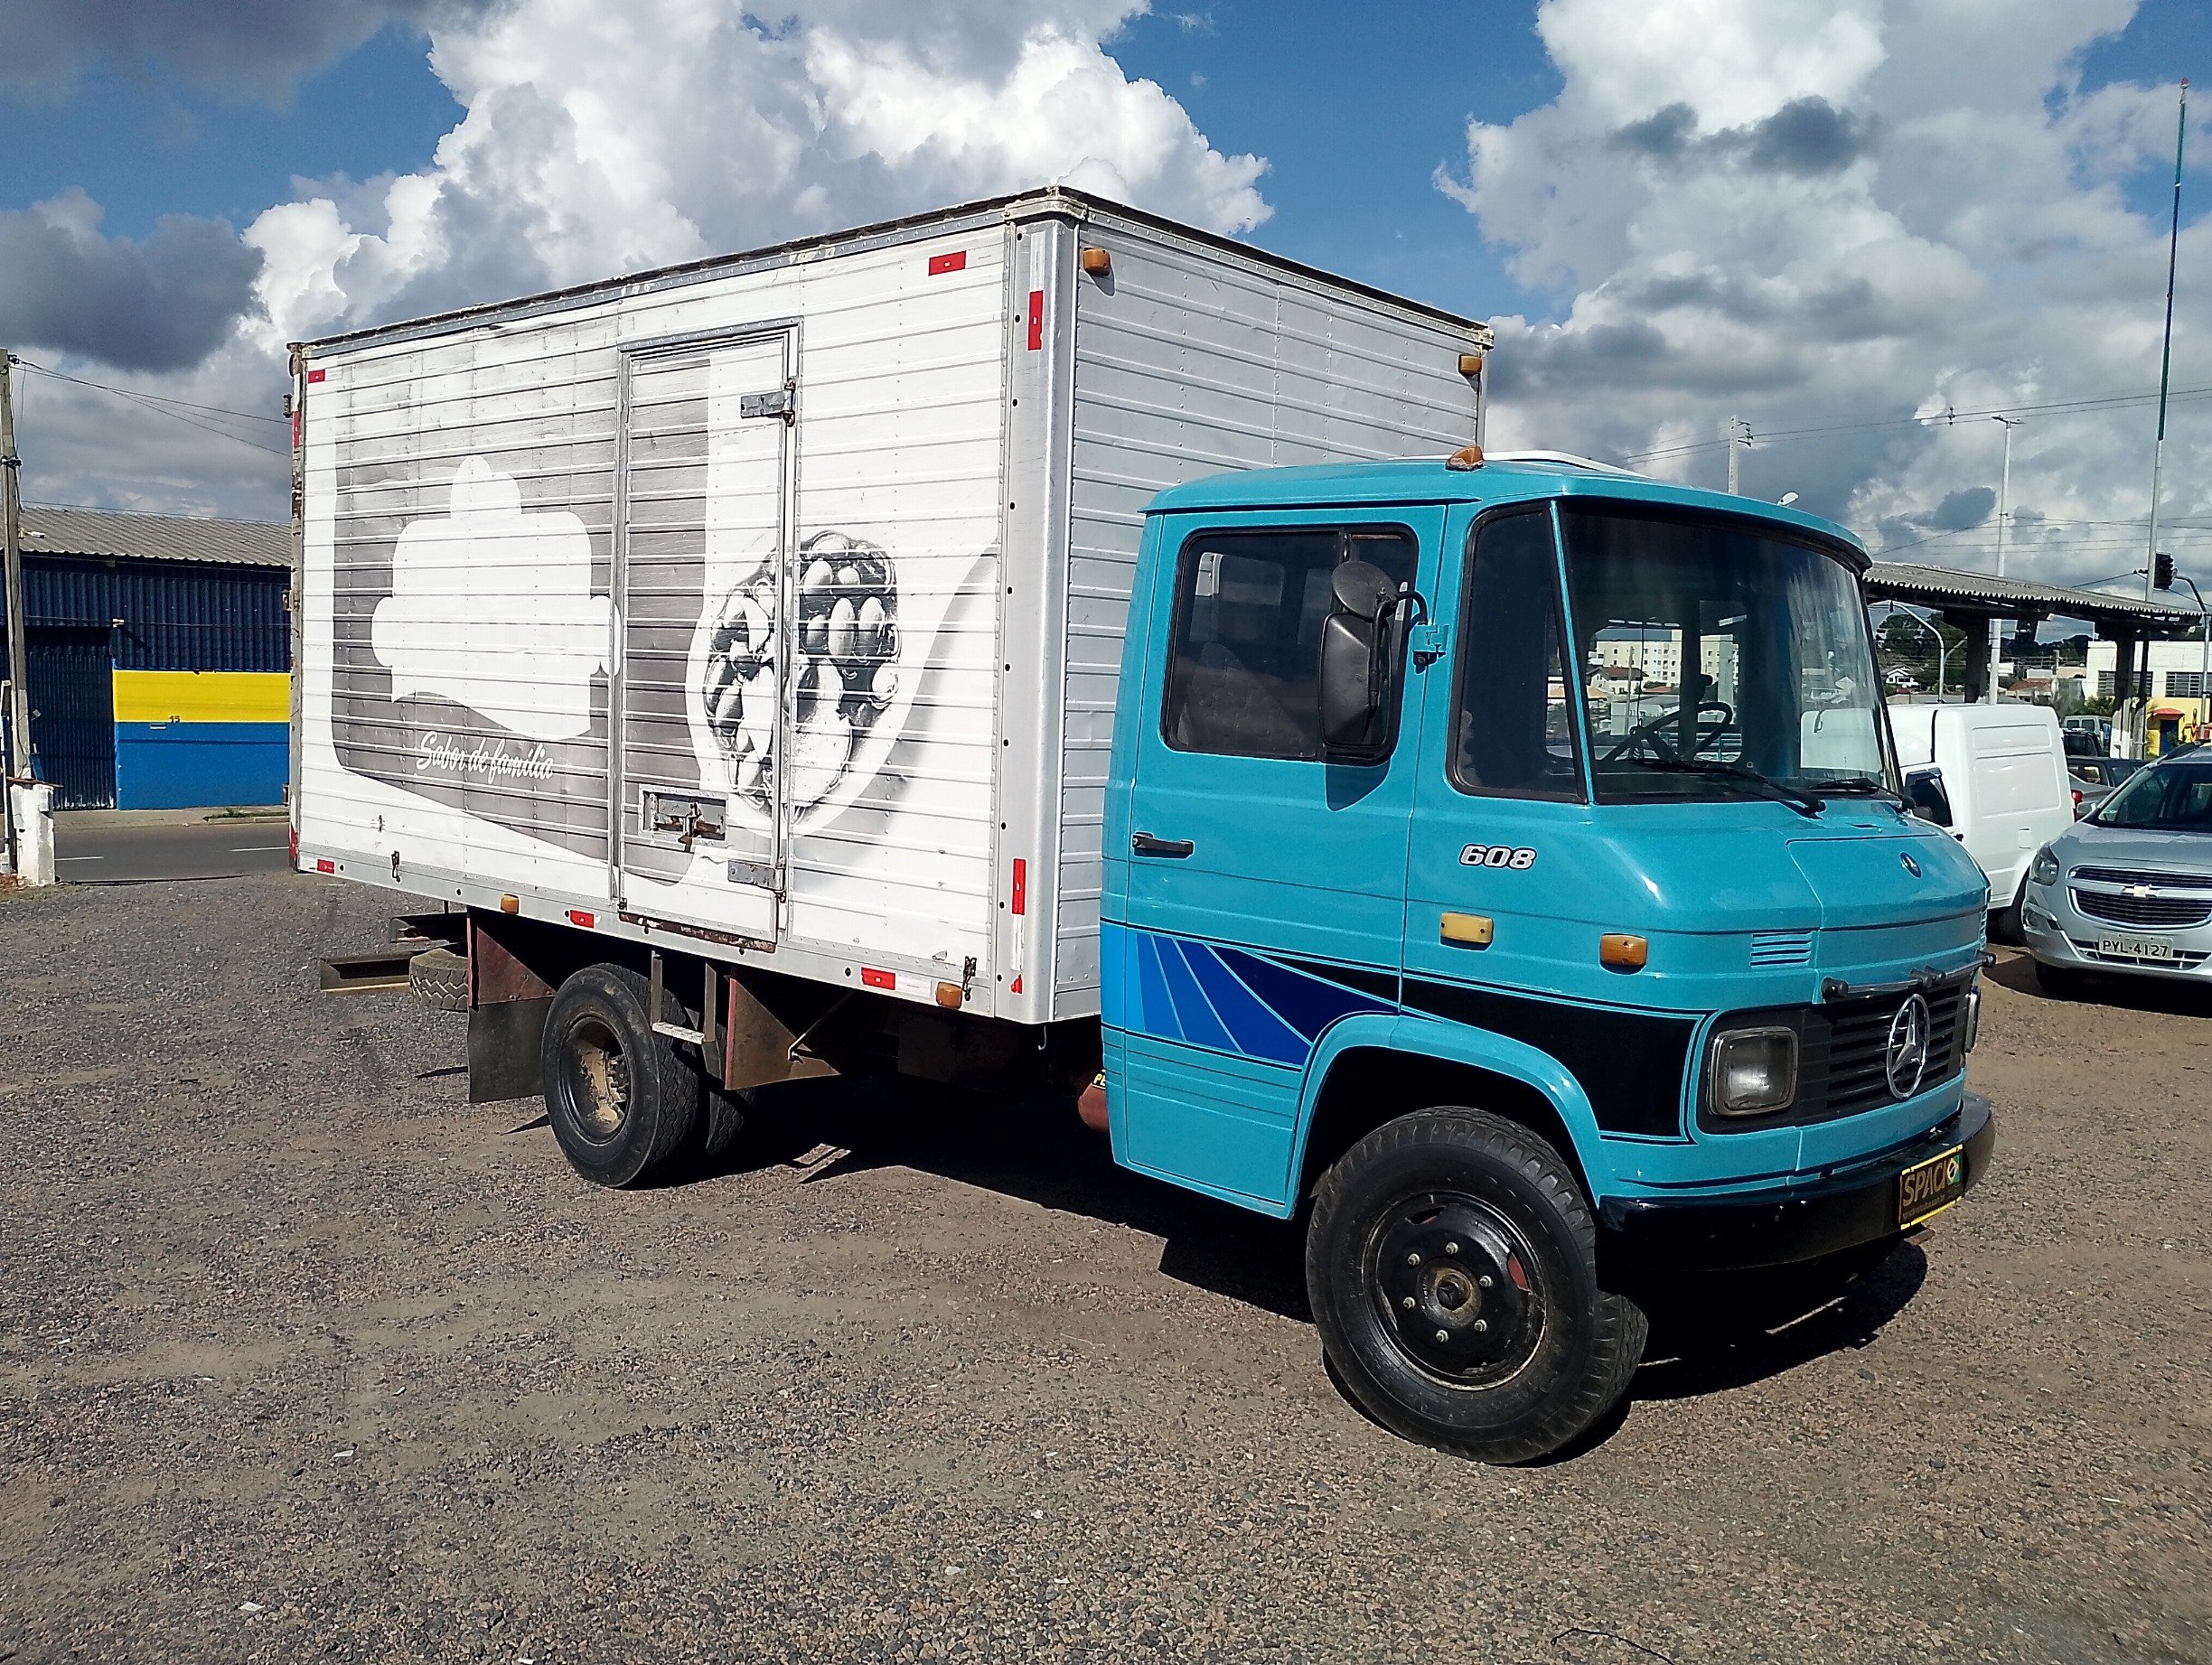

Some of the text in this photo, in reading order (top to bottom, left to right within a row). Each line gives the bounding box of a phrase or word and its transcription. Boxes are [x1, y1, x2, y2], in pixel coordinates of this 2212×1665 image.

[417, 730, 465, 772] Sabor
[467, 736, 490, 773] de
[1459, 844, 1537, 869] 608
